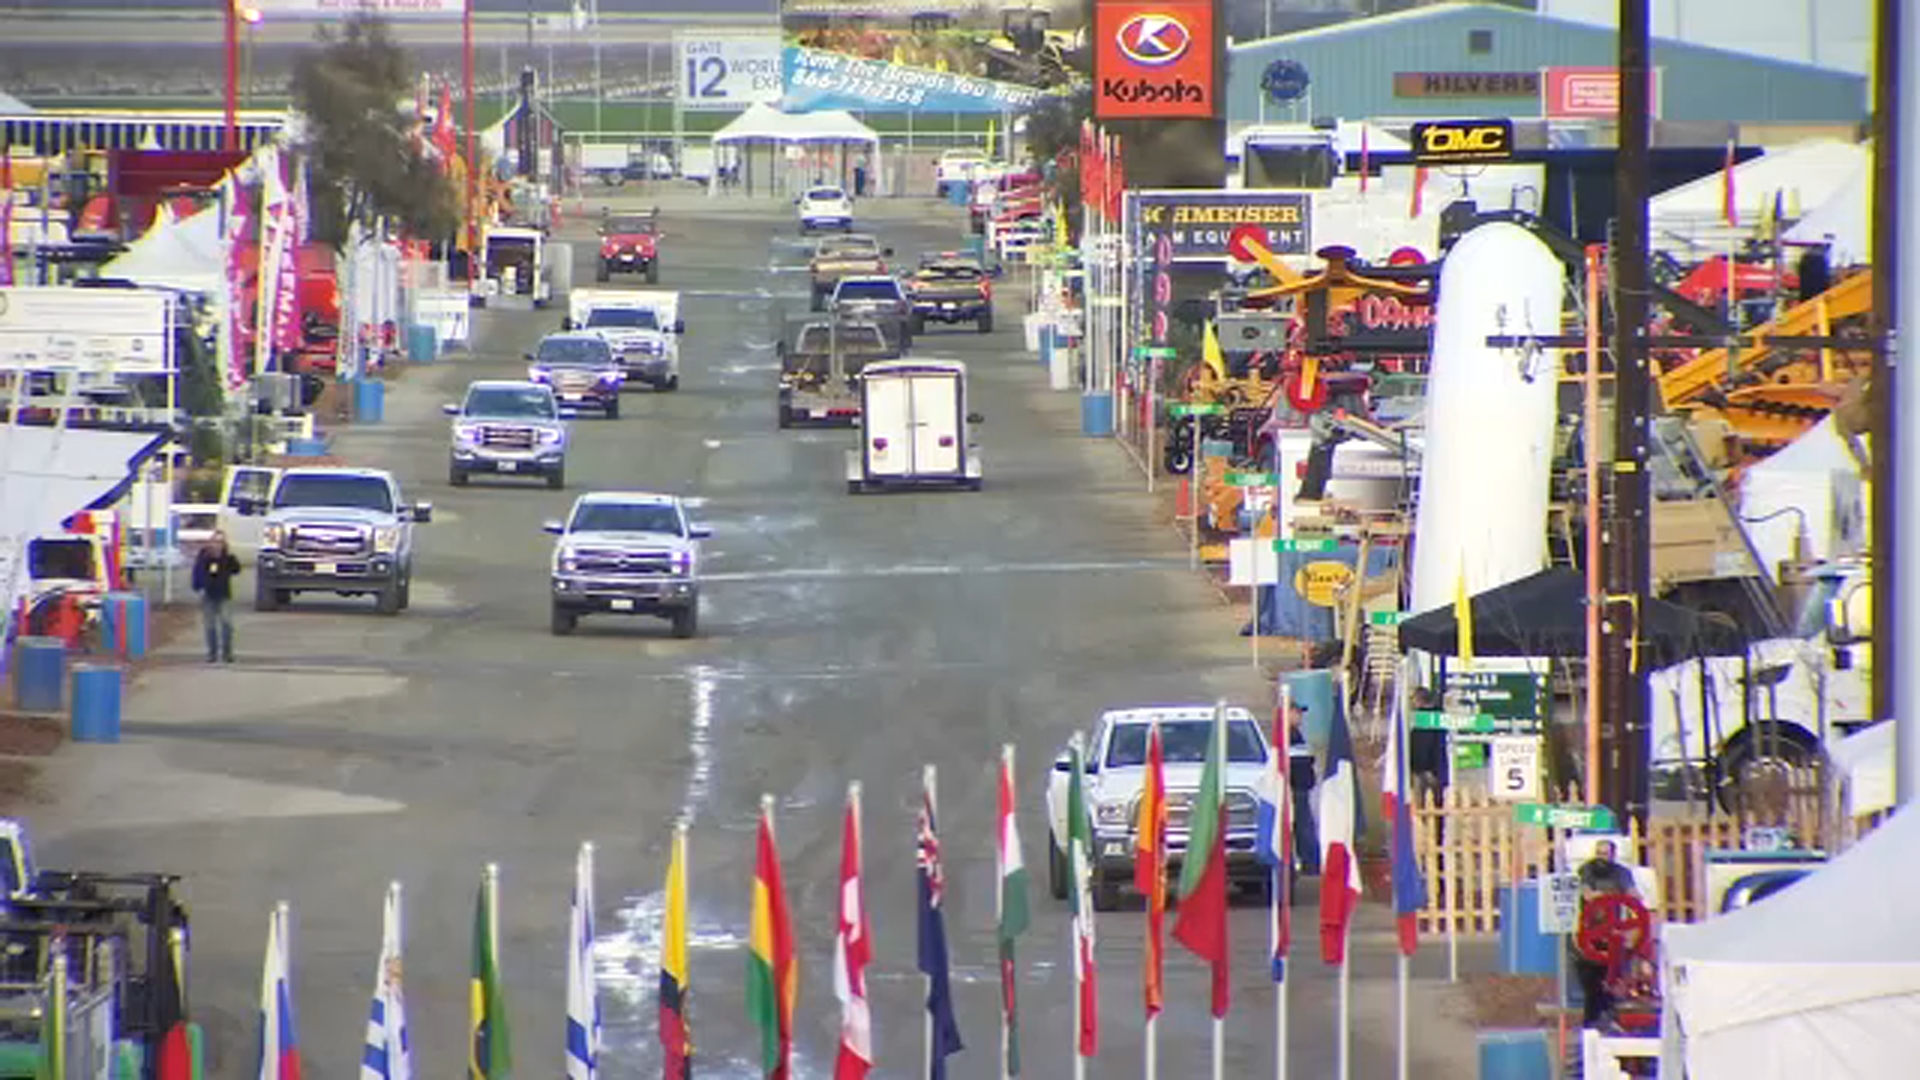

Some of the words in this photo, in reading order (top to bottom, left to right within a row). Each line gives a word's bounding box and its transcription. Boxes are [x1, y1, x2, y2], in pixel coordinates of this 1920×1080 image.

[687, 56, 727, 97] 12
[1103, 79, 1203, 103] Kubota
[1193, 230, 1303, 246] EQUENT
[1497, 743, 1537, 754] SPEED
[1501, 756, 1531, 765] LIMIT
[1507, 767, 1525, 790] 5
